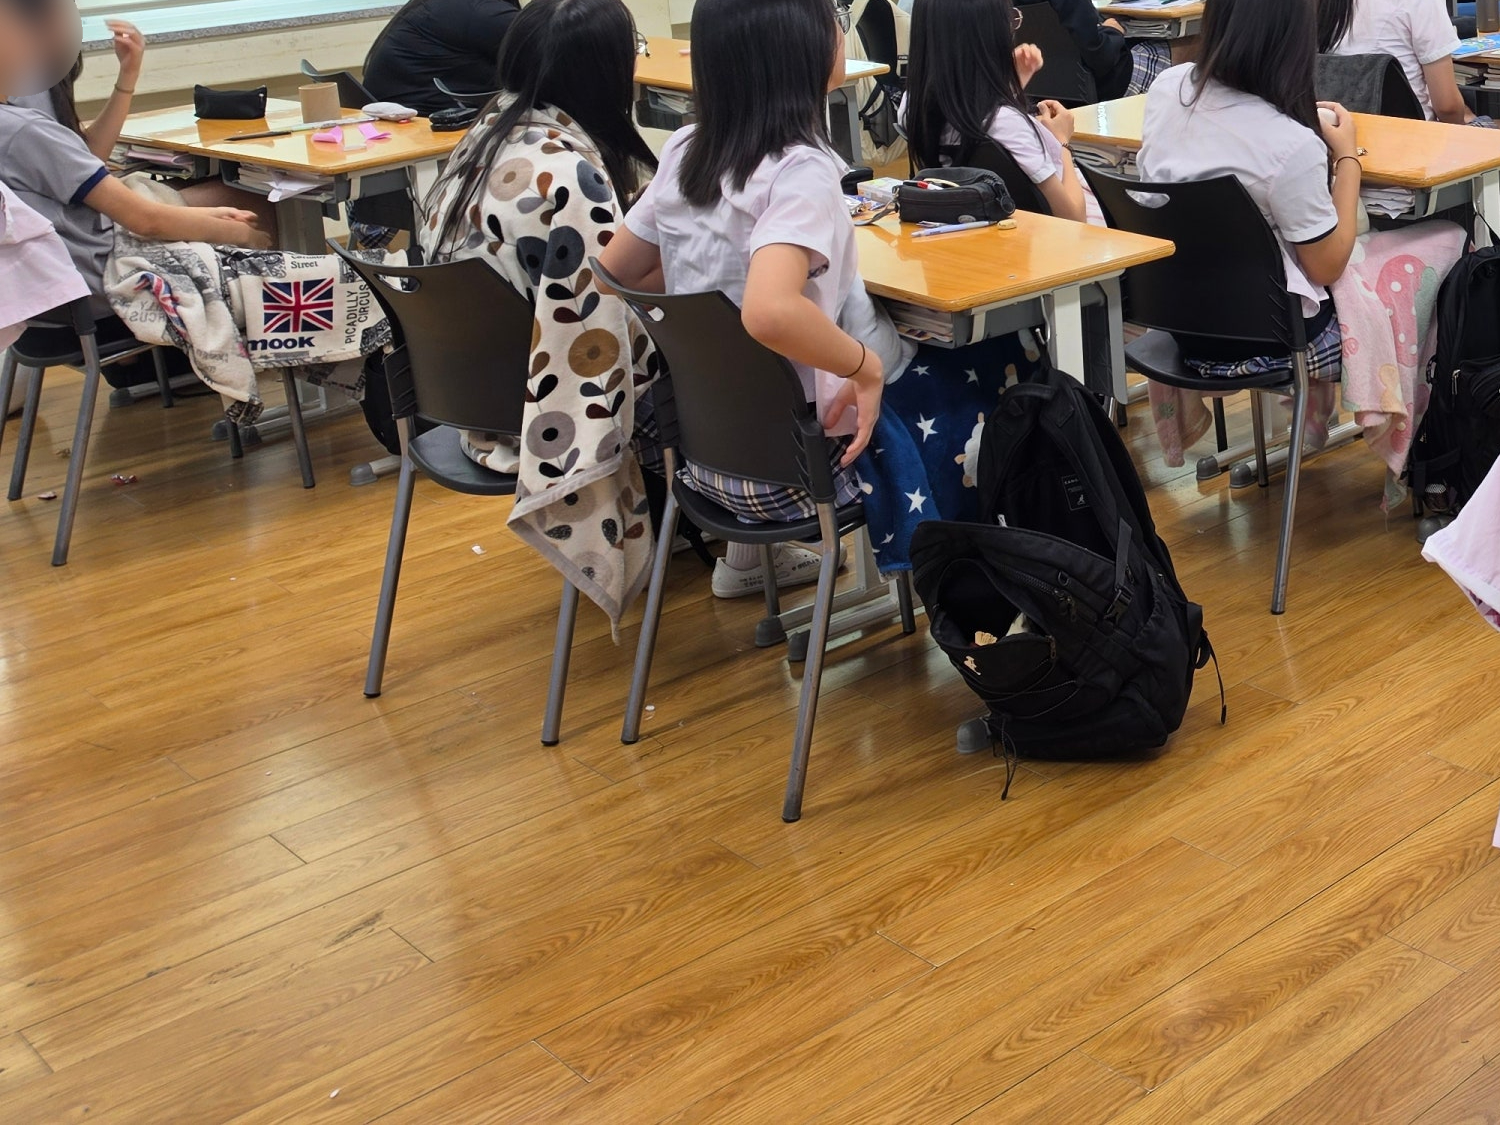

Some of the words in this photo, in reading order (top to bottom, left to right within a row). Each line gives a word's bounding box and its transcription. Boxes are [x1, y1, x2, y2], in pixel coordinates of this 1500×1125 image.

[290, 260, 318, 269] Street
[345, 290, 358, 345] PICADILLY
[358, 284, 370, 323] CIRCUS
